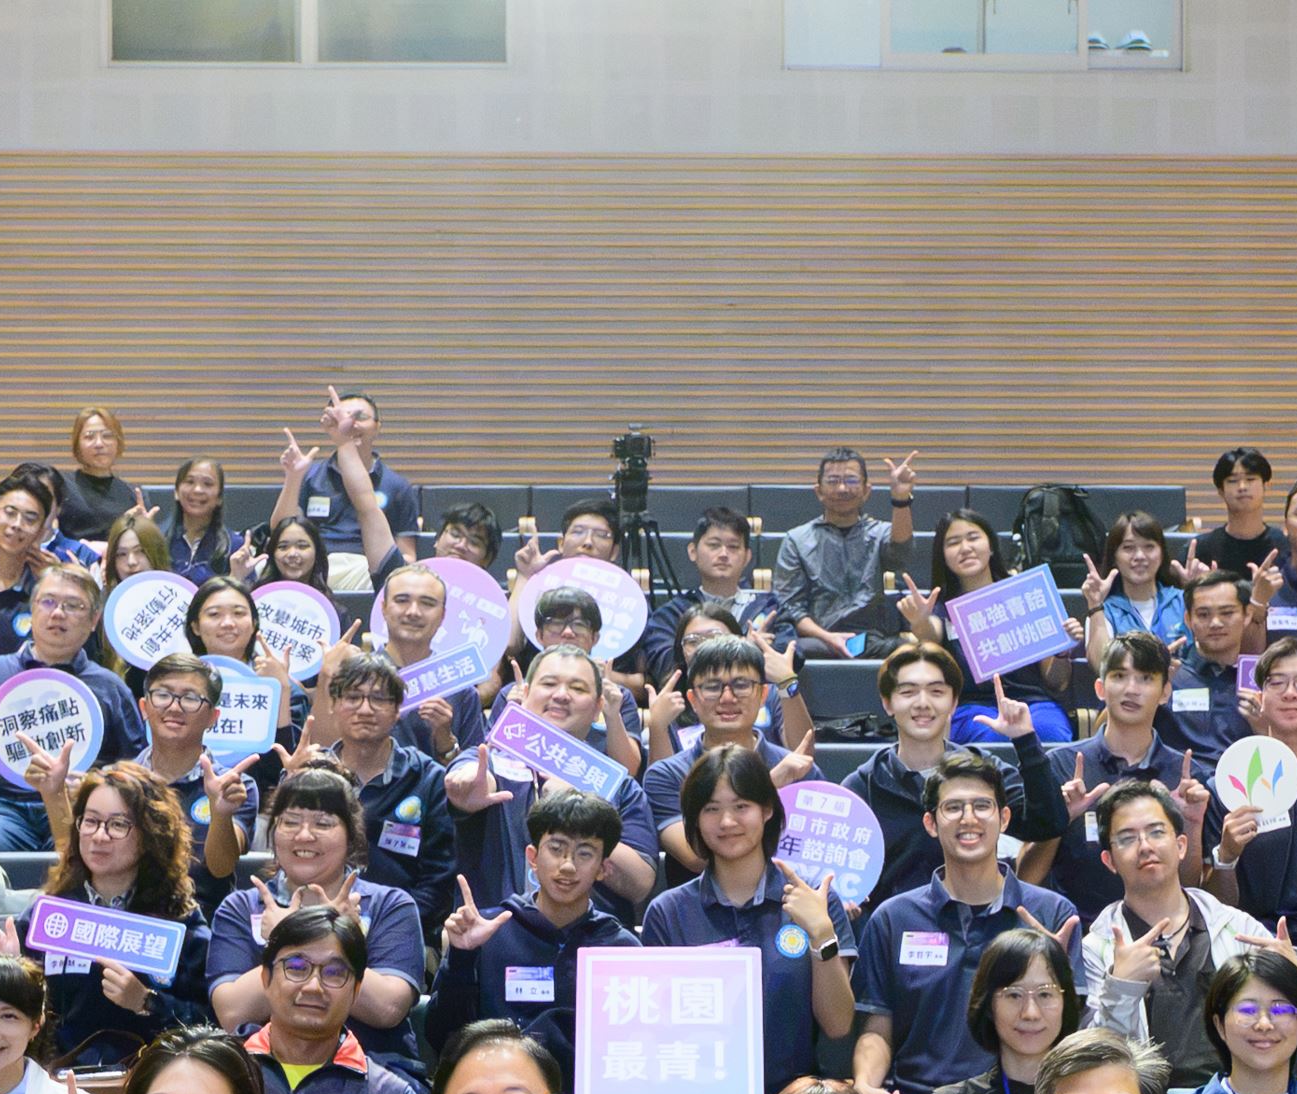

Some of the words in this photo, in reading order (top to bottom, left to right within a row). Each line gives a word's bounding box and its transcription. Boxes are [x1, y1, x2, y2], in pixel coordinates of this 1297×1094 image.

[257, 602, 326, 642] 改變城市
[977, 614, 1058, 662] 共創桃園
[259, 628, 317, 664] 我提案
[404, 655, 477, 700] 智慧生活
[0, 696, 80, 737] 洞察痛點
[523, 732, 610, 791] 公共參與
[70, 917, 168, 961] 國際展望
[602, 975, 724, 1026] 桃園
